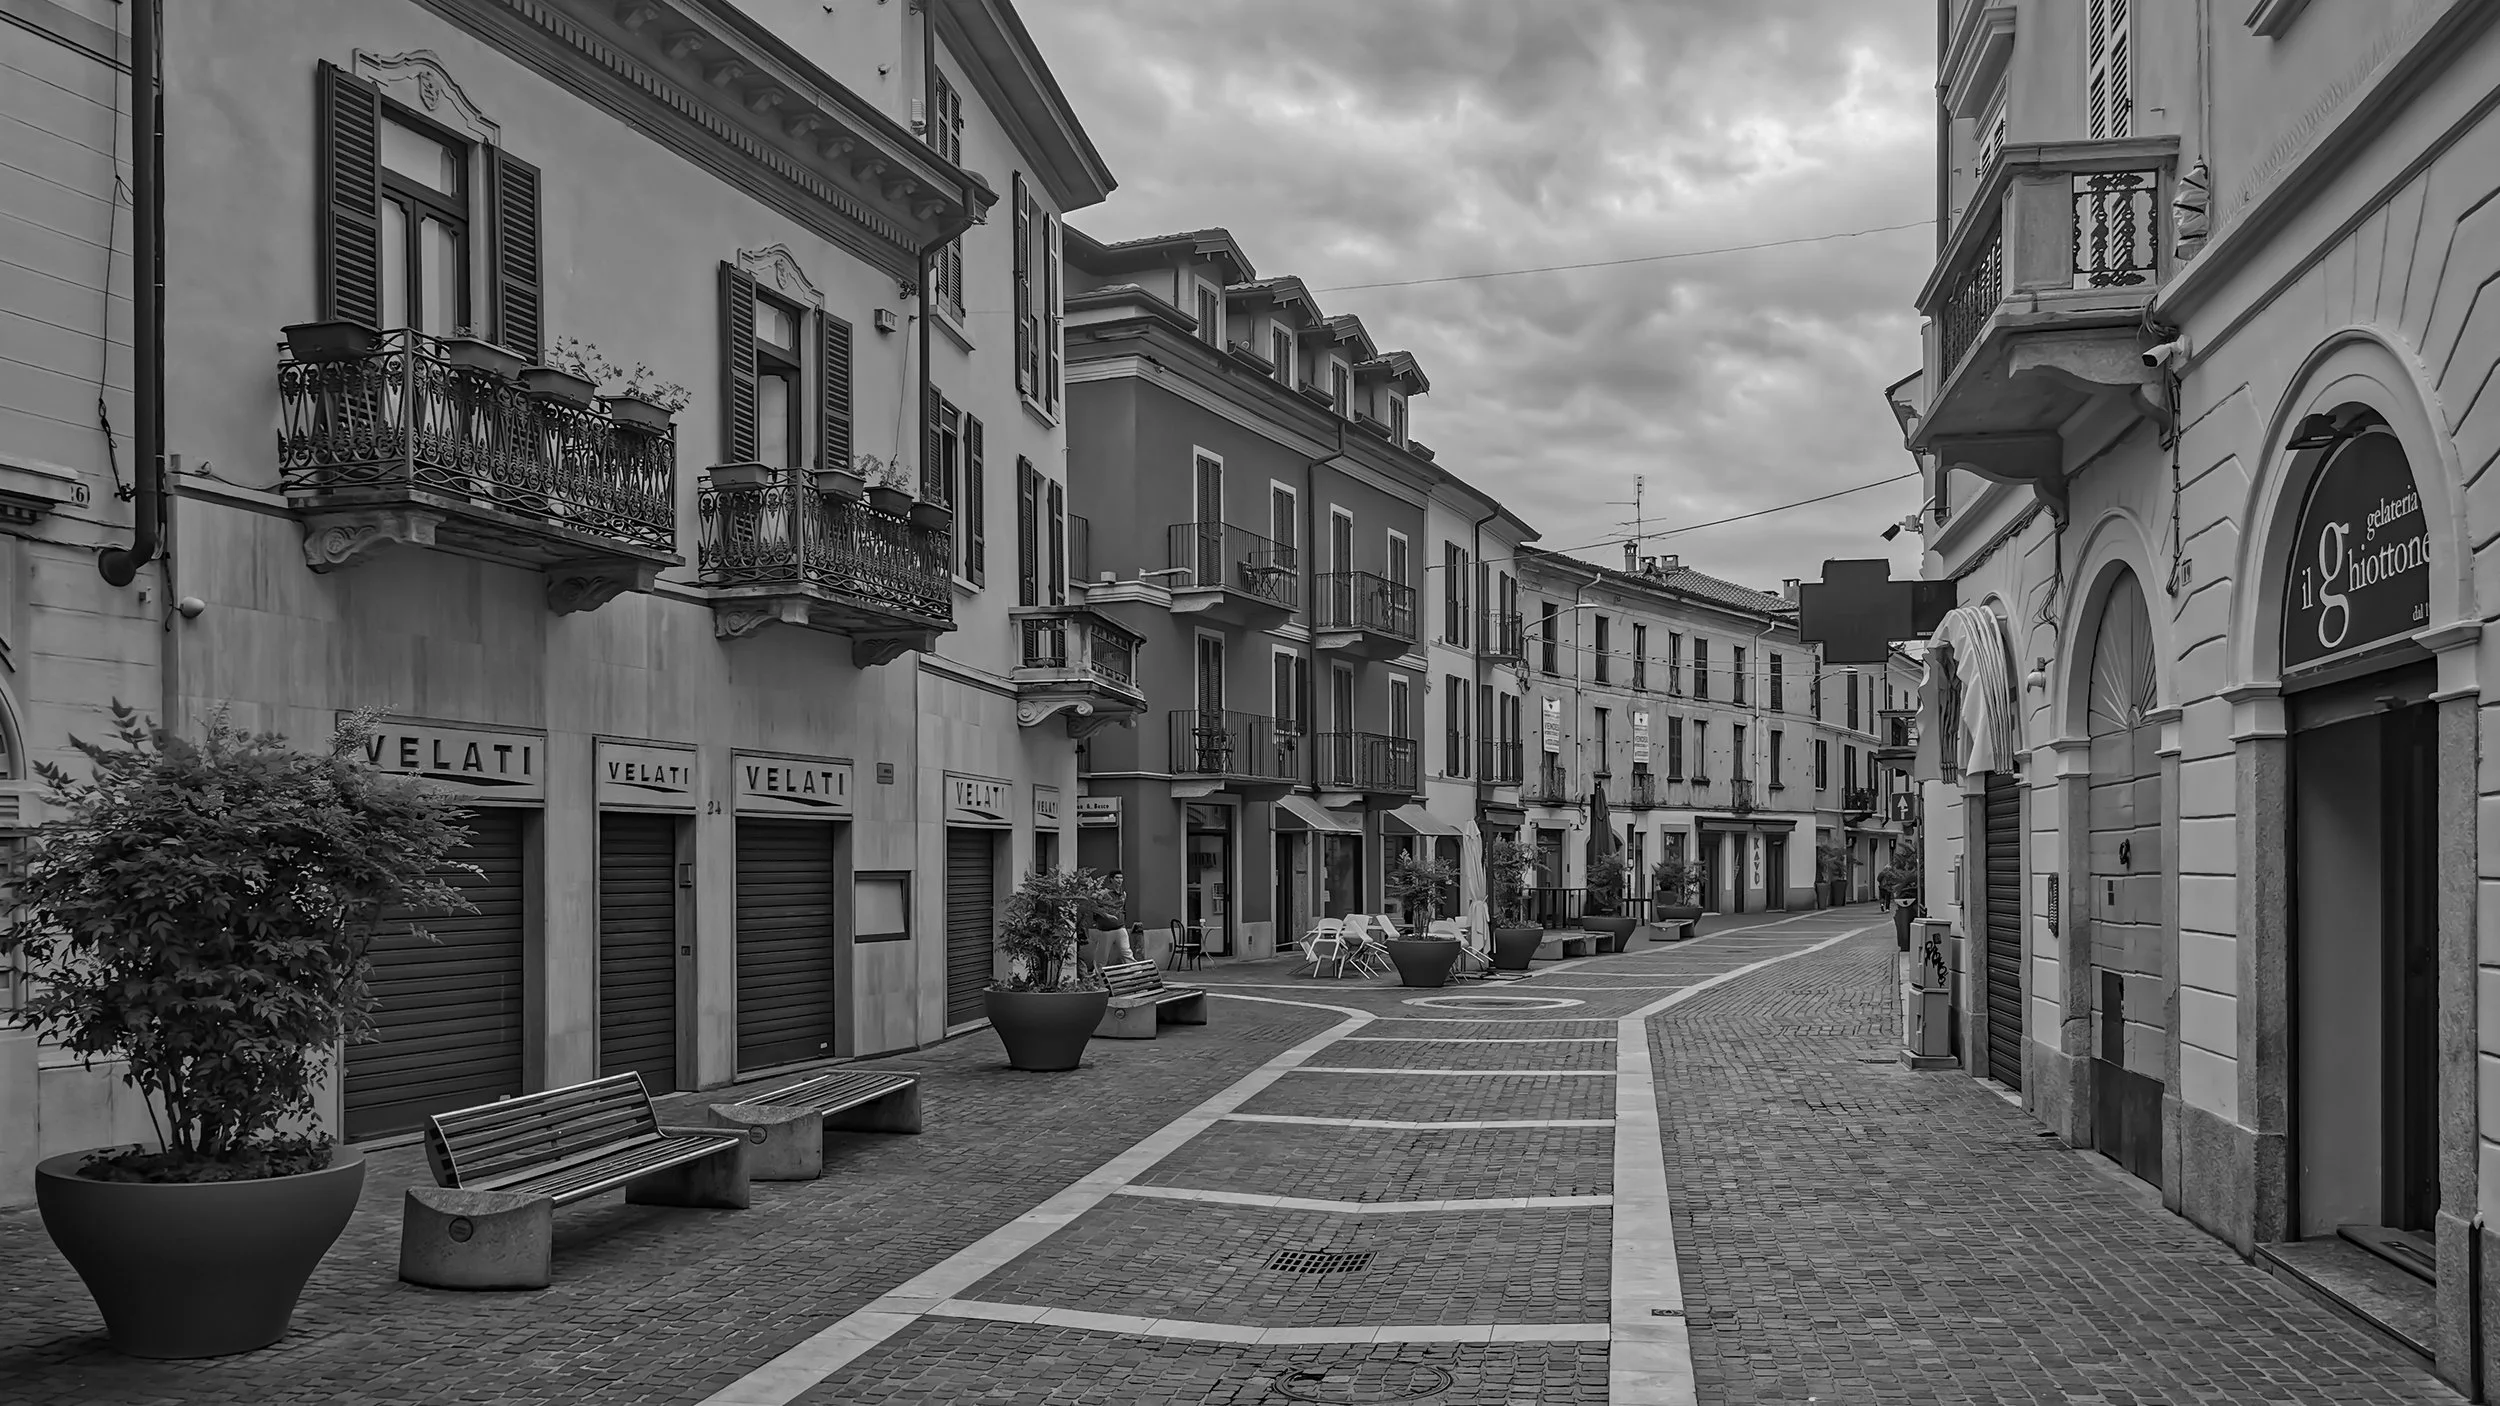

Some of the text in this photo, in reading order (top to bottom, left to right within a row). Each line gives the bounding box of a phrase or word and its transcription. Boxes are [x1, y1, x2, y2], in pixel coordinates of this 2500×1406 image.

[2366, 484, 2419, 541] gelateria
[2301, 521, 2430, 648] il ghiottone
[364, 734, 532, 776] VELATI
[608, 761, 689, 785] VELATI
[745, 765, 845, 796] VELATI
[706, 800, 722, 816] 24
[956, 781, 1005, 809] VELATI
[1037, 800, 1058, 814] VELATI
